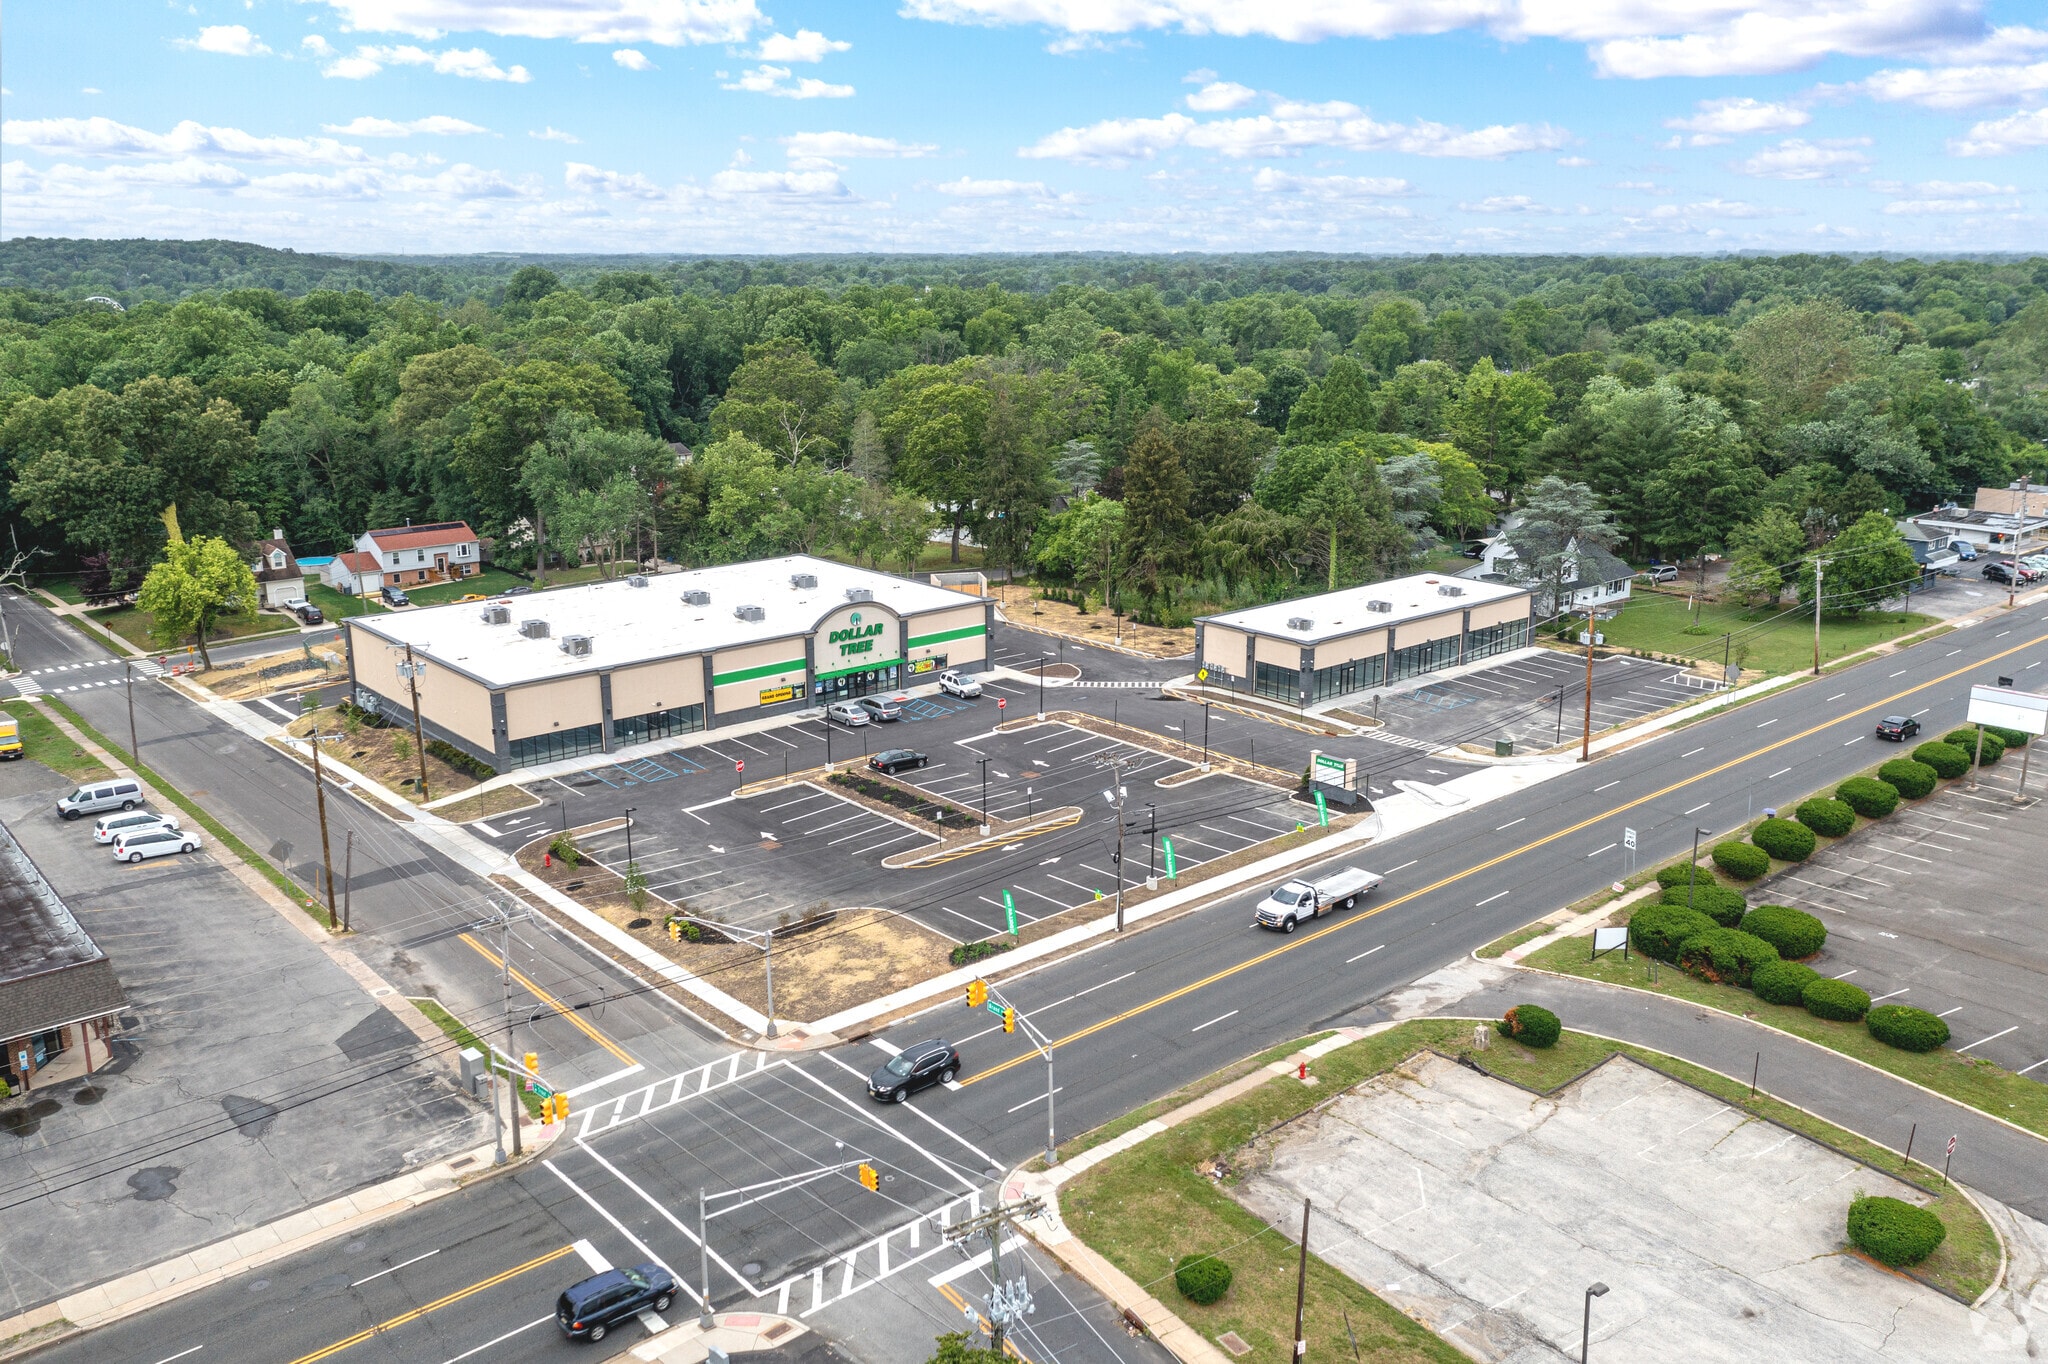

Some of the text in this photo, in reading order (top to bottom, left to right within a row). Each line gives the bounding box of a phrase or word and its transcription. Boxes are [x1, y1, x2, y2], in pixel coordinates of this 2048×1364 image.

[828, 622, 884, 644] DOLLAR
[839, 639, 874, 657] TREE
[1626, 840, 1635, 848] 40
